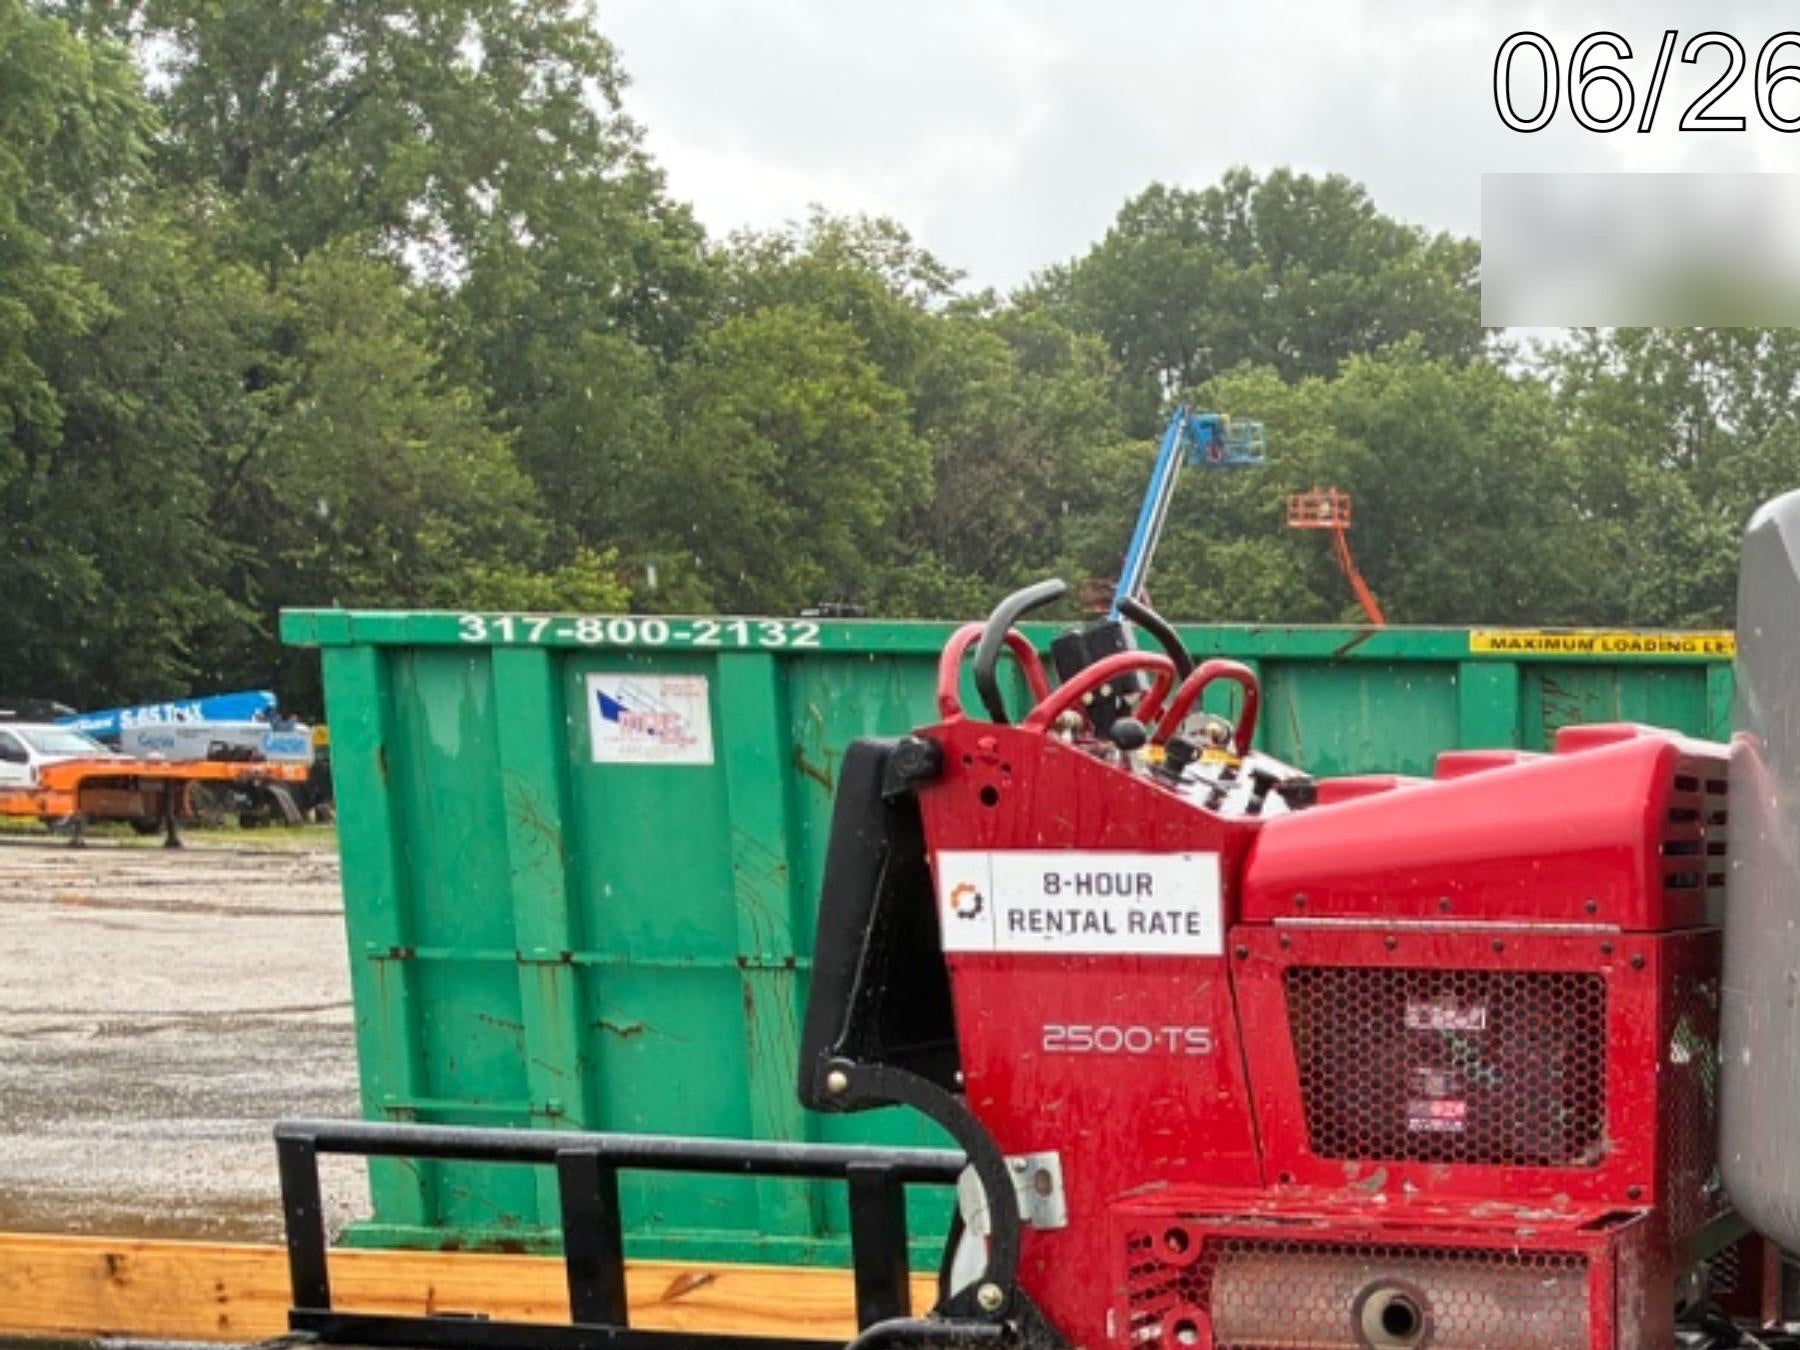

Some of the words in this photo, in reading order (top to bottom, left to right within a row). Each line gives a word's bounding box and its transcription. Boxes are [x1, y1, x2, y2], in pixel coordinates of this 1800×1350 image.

[458, 615, 822, 647] 317-800-2132
[1490, 637, 1594, 651] MAXIMUM
[1602, 638, 1696, 652] LOADING
[1703, 639, 1735, 653] LE
[1042, 872, 1154, 897] 8-HOUR
[1007, 908, 1117, 935] RENTAL
[1127, 910, 1201, 936] RATE
